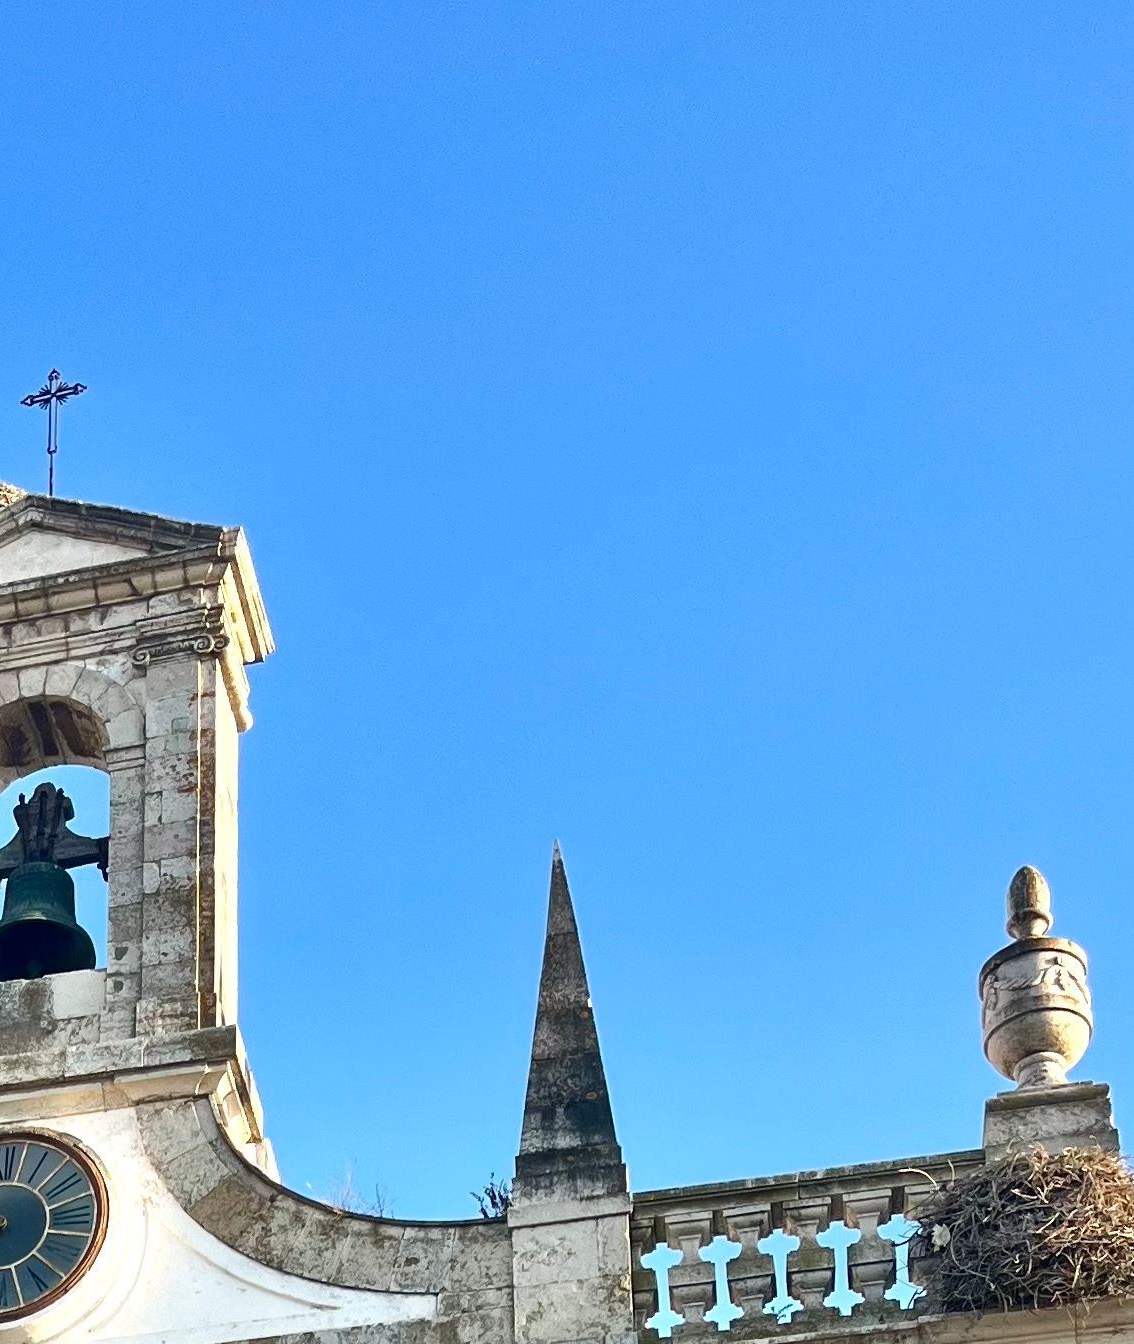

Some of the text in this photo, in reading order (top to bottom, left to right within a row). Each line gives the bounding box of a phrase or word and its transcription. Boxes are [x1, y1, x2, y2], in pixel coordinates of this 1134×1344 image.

[27, 1151, 49, 1184] I
[45, 1172, 83, 1200] II
[53, 1205, 91, 1226] III
